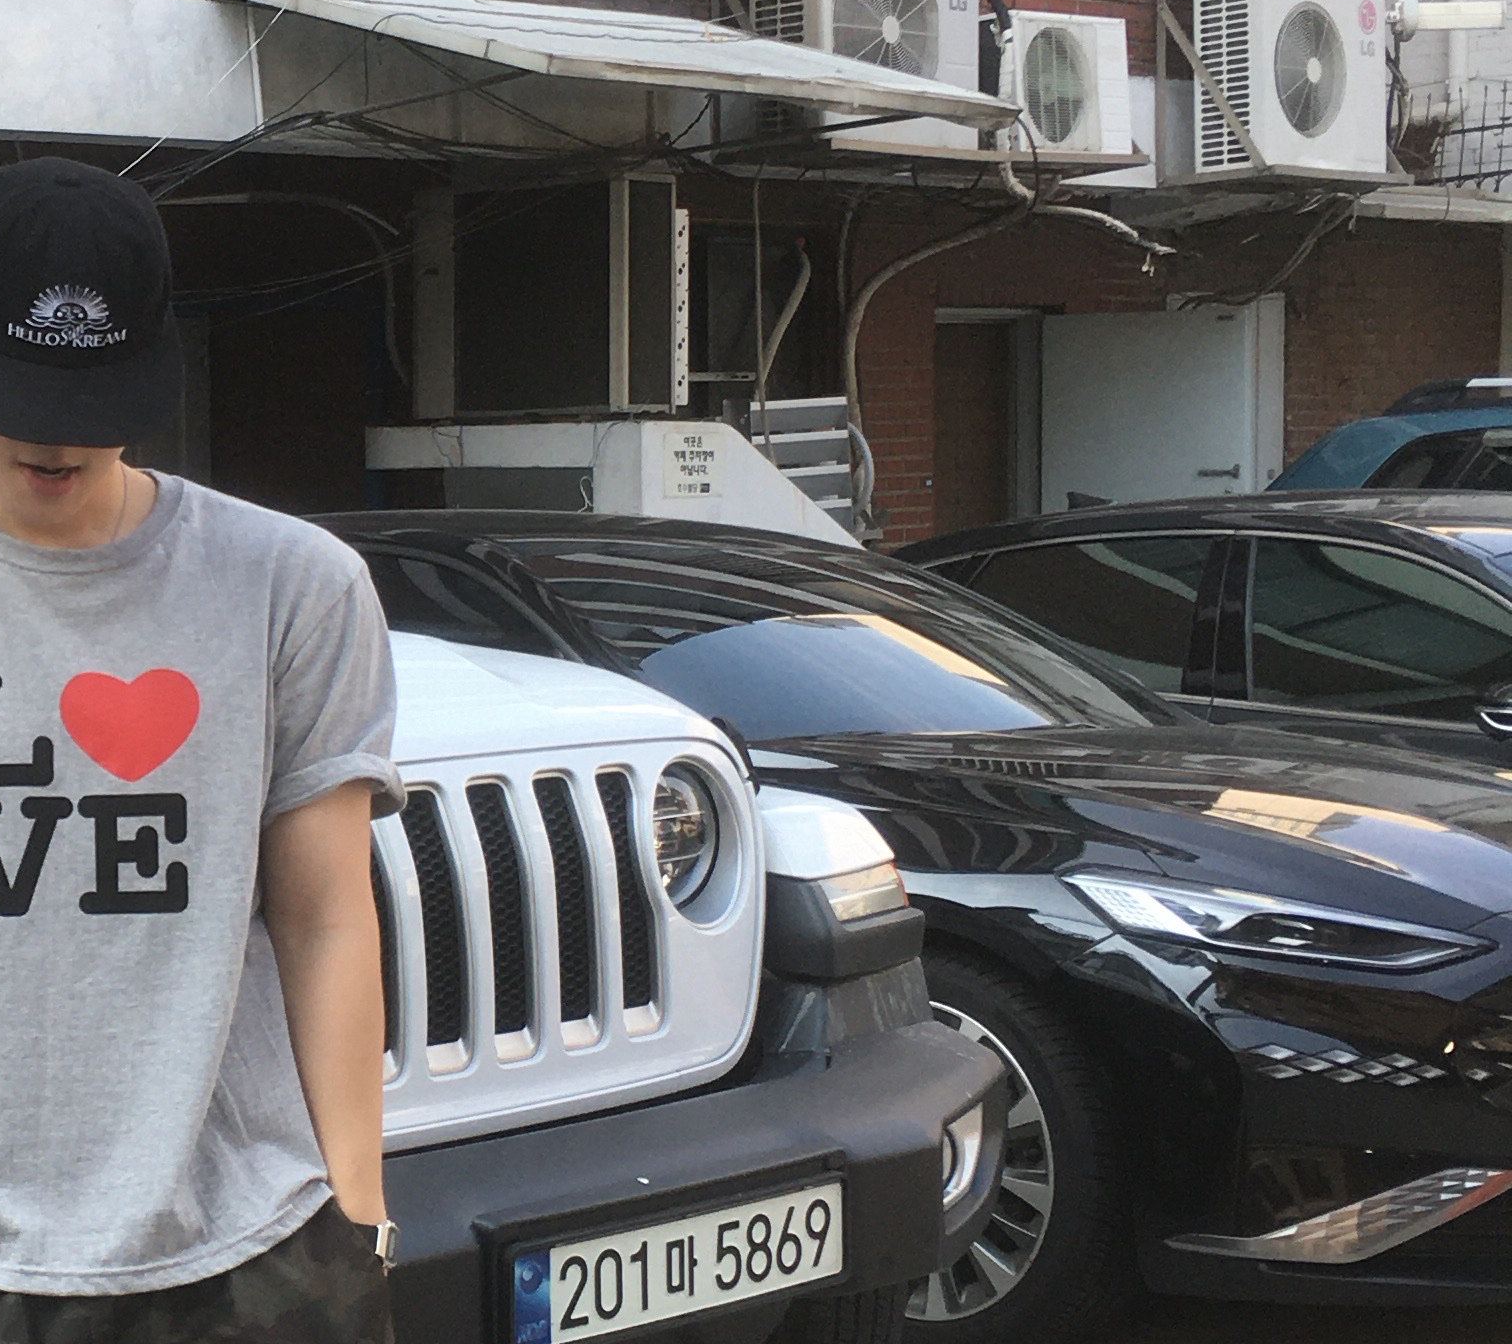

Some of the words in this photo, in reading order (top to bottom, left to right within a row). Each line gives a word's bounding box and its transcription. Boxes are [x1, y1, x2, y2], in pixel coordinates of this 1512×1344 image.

[1360, 39, 1376, 57] LG
[559, 1234, 698, 1330] 201마
[715, 1199, 831, 1290] 5869
